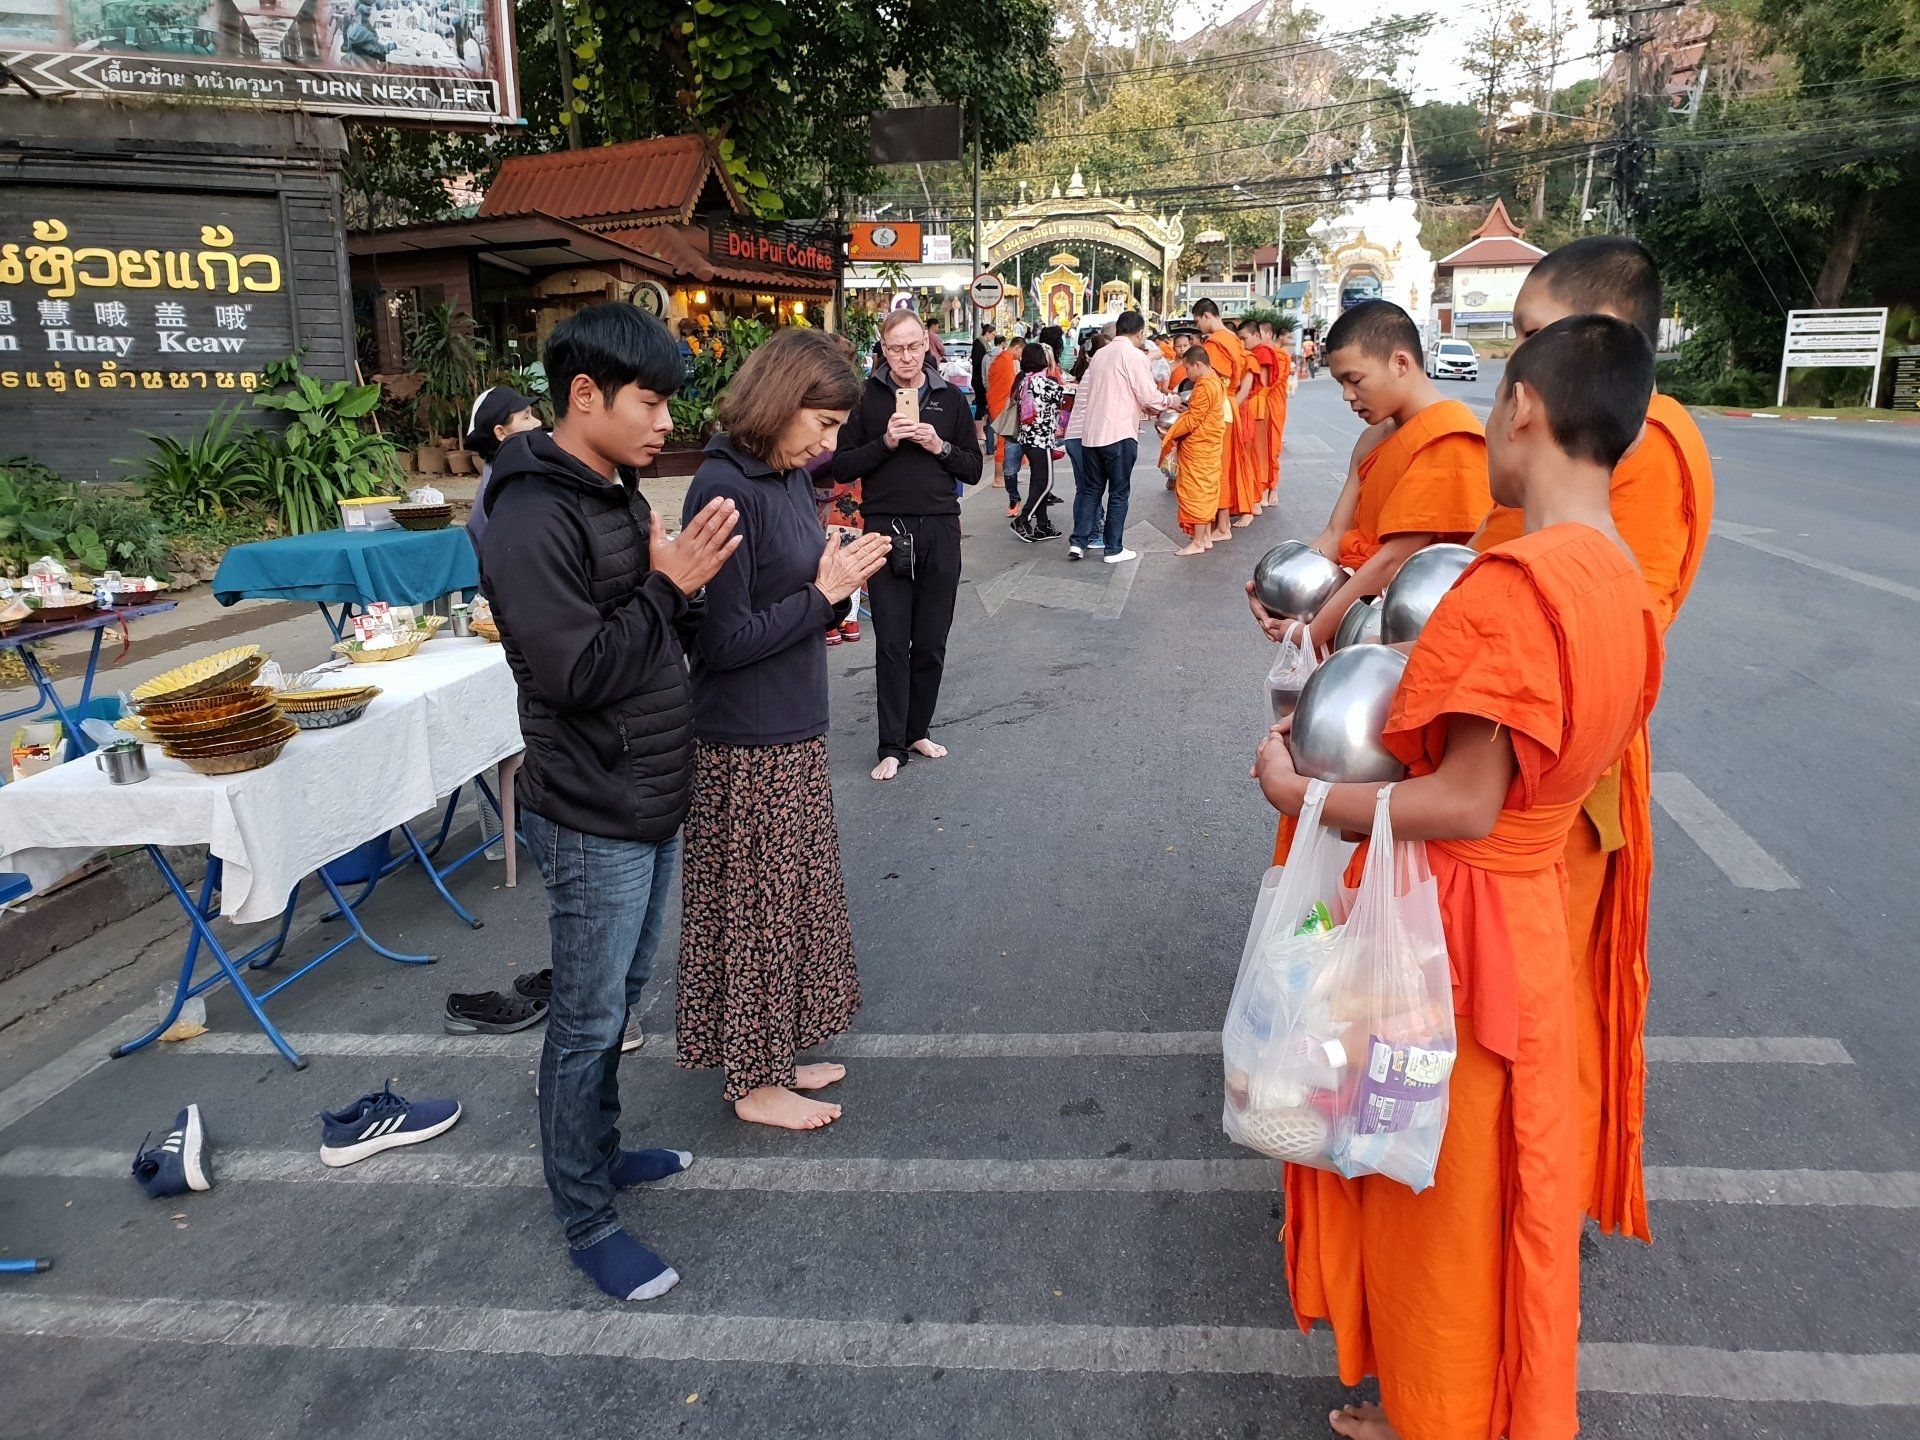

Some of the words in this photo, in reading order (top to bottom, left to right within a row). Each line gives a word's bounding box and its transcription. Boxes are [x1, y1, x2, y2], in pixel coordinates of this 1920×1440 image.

[100, 59, 186, 87] เลี้ยวซ้าย
[194, 70, 284, 98] หน้าครูบา
[296, 78, 363, 98] TURN
[371, 84, 432, 101] NEXT
[440, 88, 491, 105] LEFT
[728, 232, 755, 259] Doi
[759, 235, 783, 264] Pui
[786, 242, 833, 271] Coffee
[45, 329, 136, 358] Huay
[155, 330, 246, 353] Keaw
